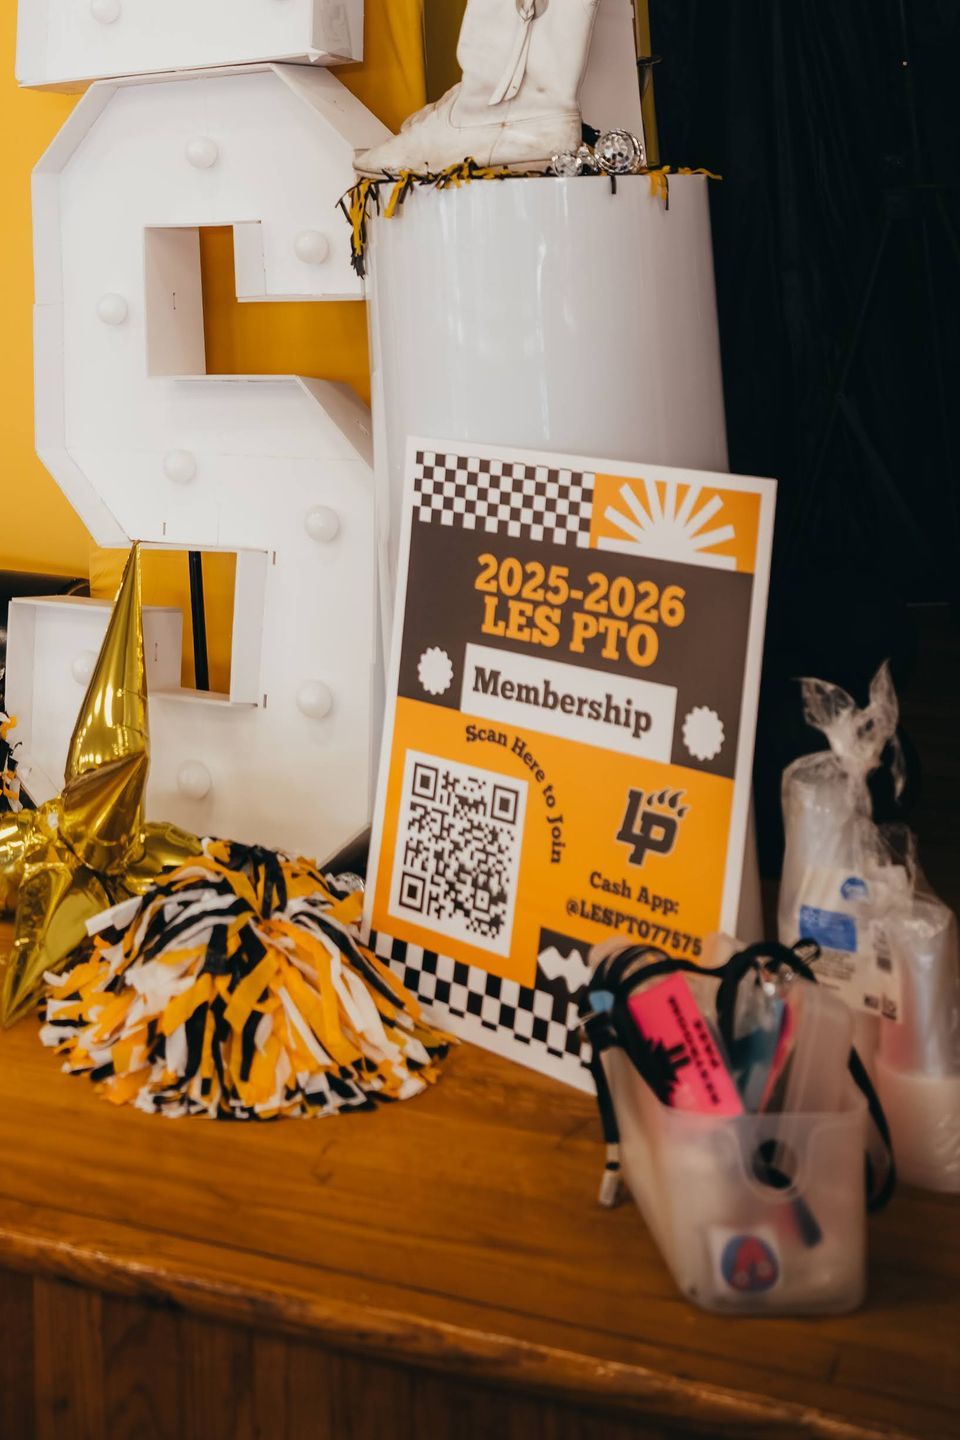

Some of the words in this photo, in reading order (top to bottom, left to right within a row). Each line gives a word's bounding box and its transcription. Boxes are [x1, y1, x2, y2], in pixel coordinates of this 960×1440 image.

[474, 553, 687, 628] 2025-2026
[481, 594, 562, 648] LES
[569, 611, 660, 668] PTO
[472, 665, 653, 739] Membership
[465, 724, 508, 748] Scan
[511, 736, 546, 783] Here
[542, 785, 556, 808] to
[546, 814, 566, 864] Join
[616, 789, 678, 867] LP
[589, 871, 632, 900] Cash
[637, 886, 680, 916] App:
[565, 898, 703, 957] @LESPTO77575
